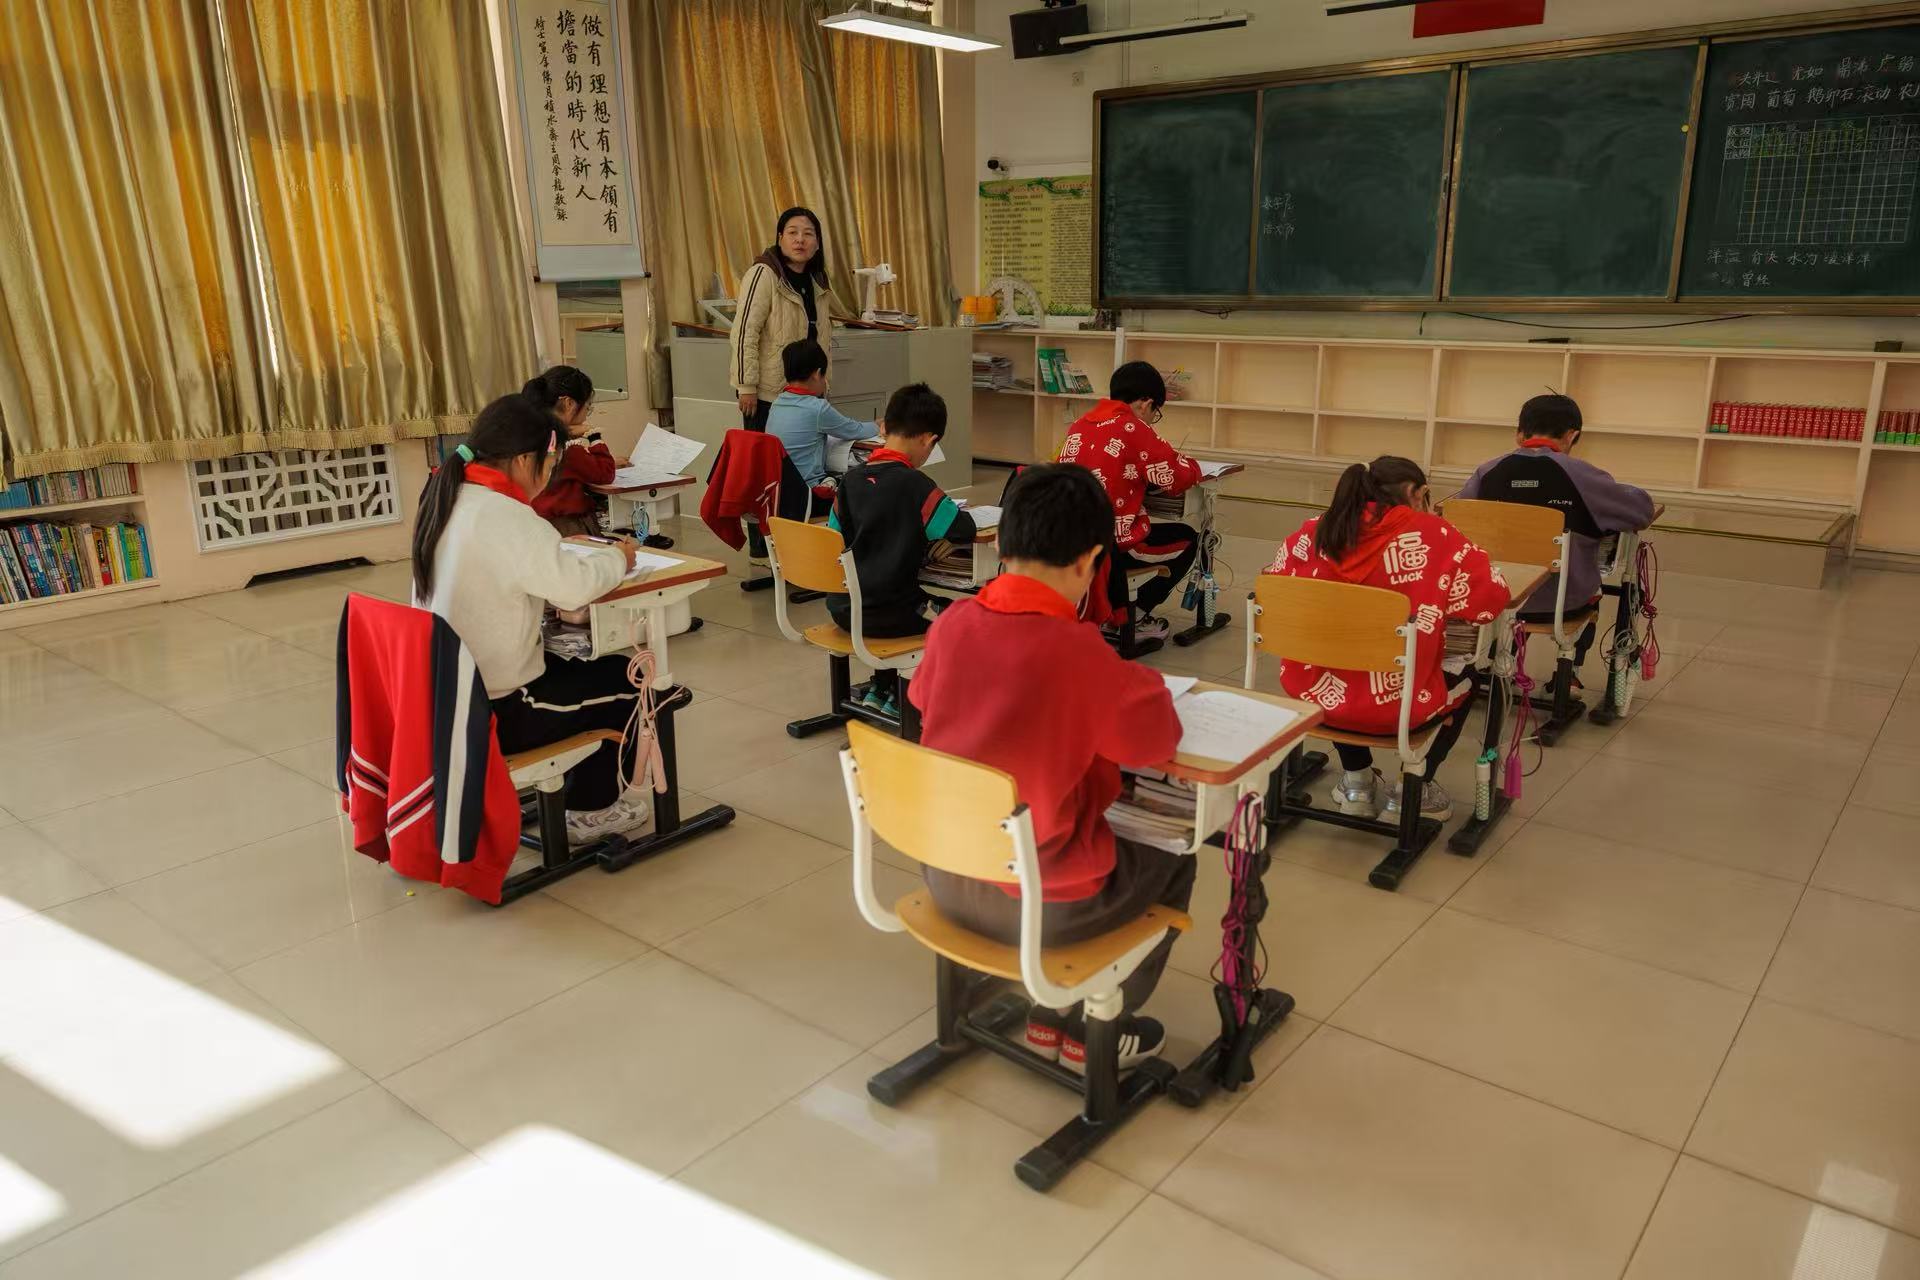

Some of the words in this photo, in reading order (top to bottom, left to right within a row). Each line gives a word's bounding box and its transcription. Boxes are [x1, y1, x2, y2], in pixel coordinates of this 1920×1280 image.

[1767, 89, 1797, 108] 葡萄
[1383, 531, 1432, 575] 福
[1390, 570, 1424, 585] LUCK
